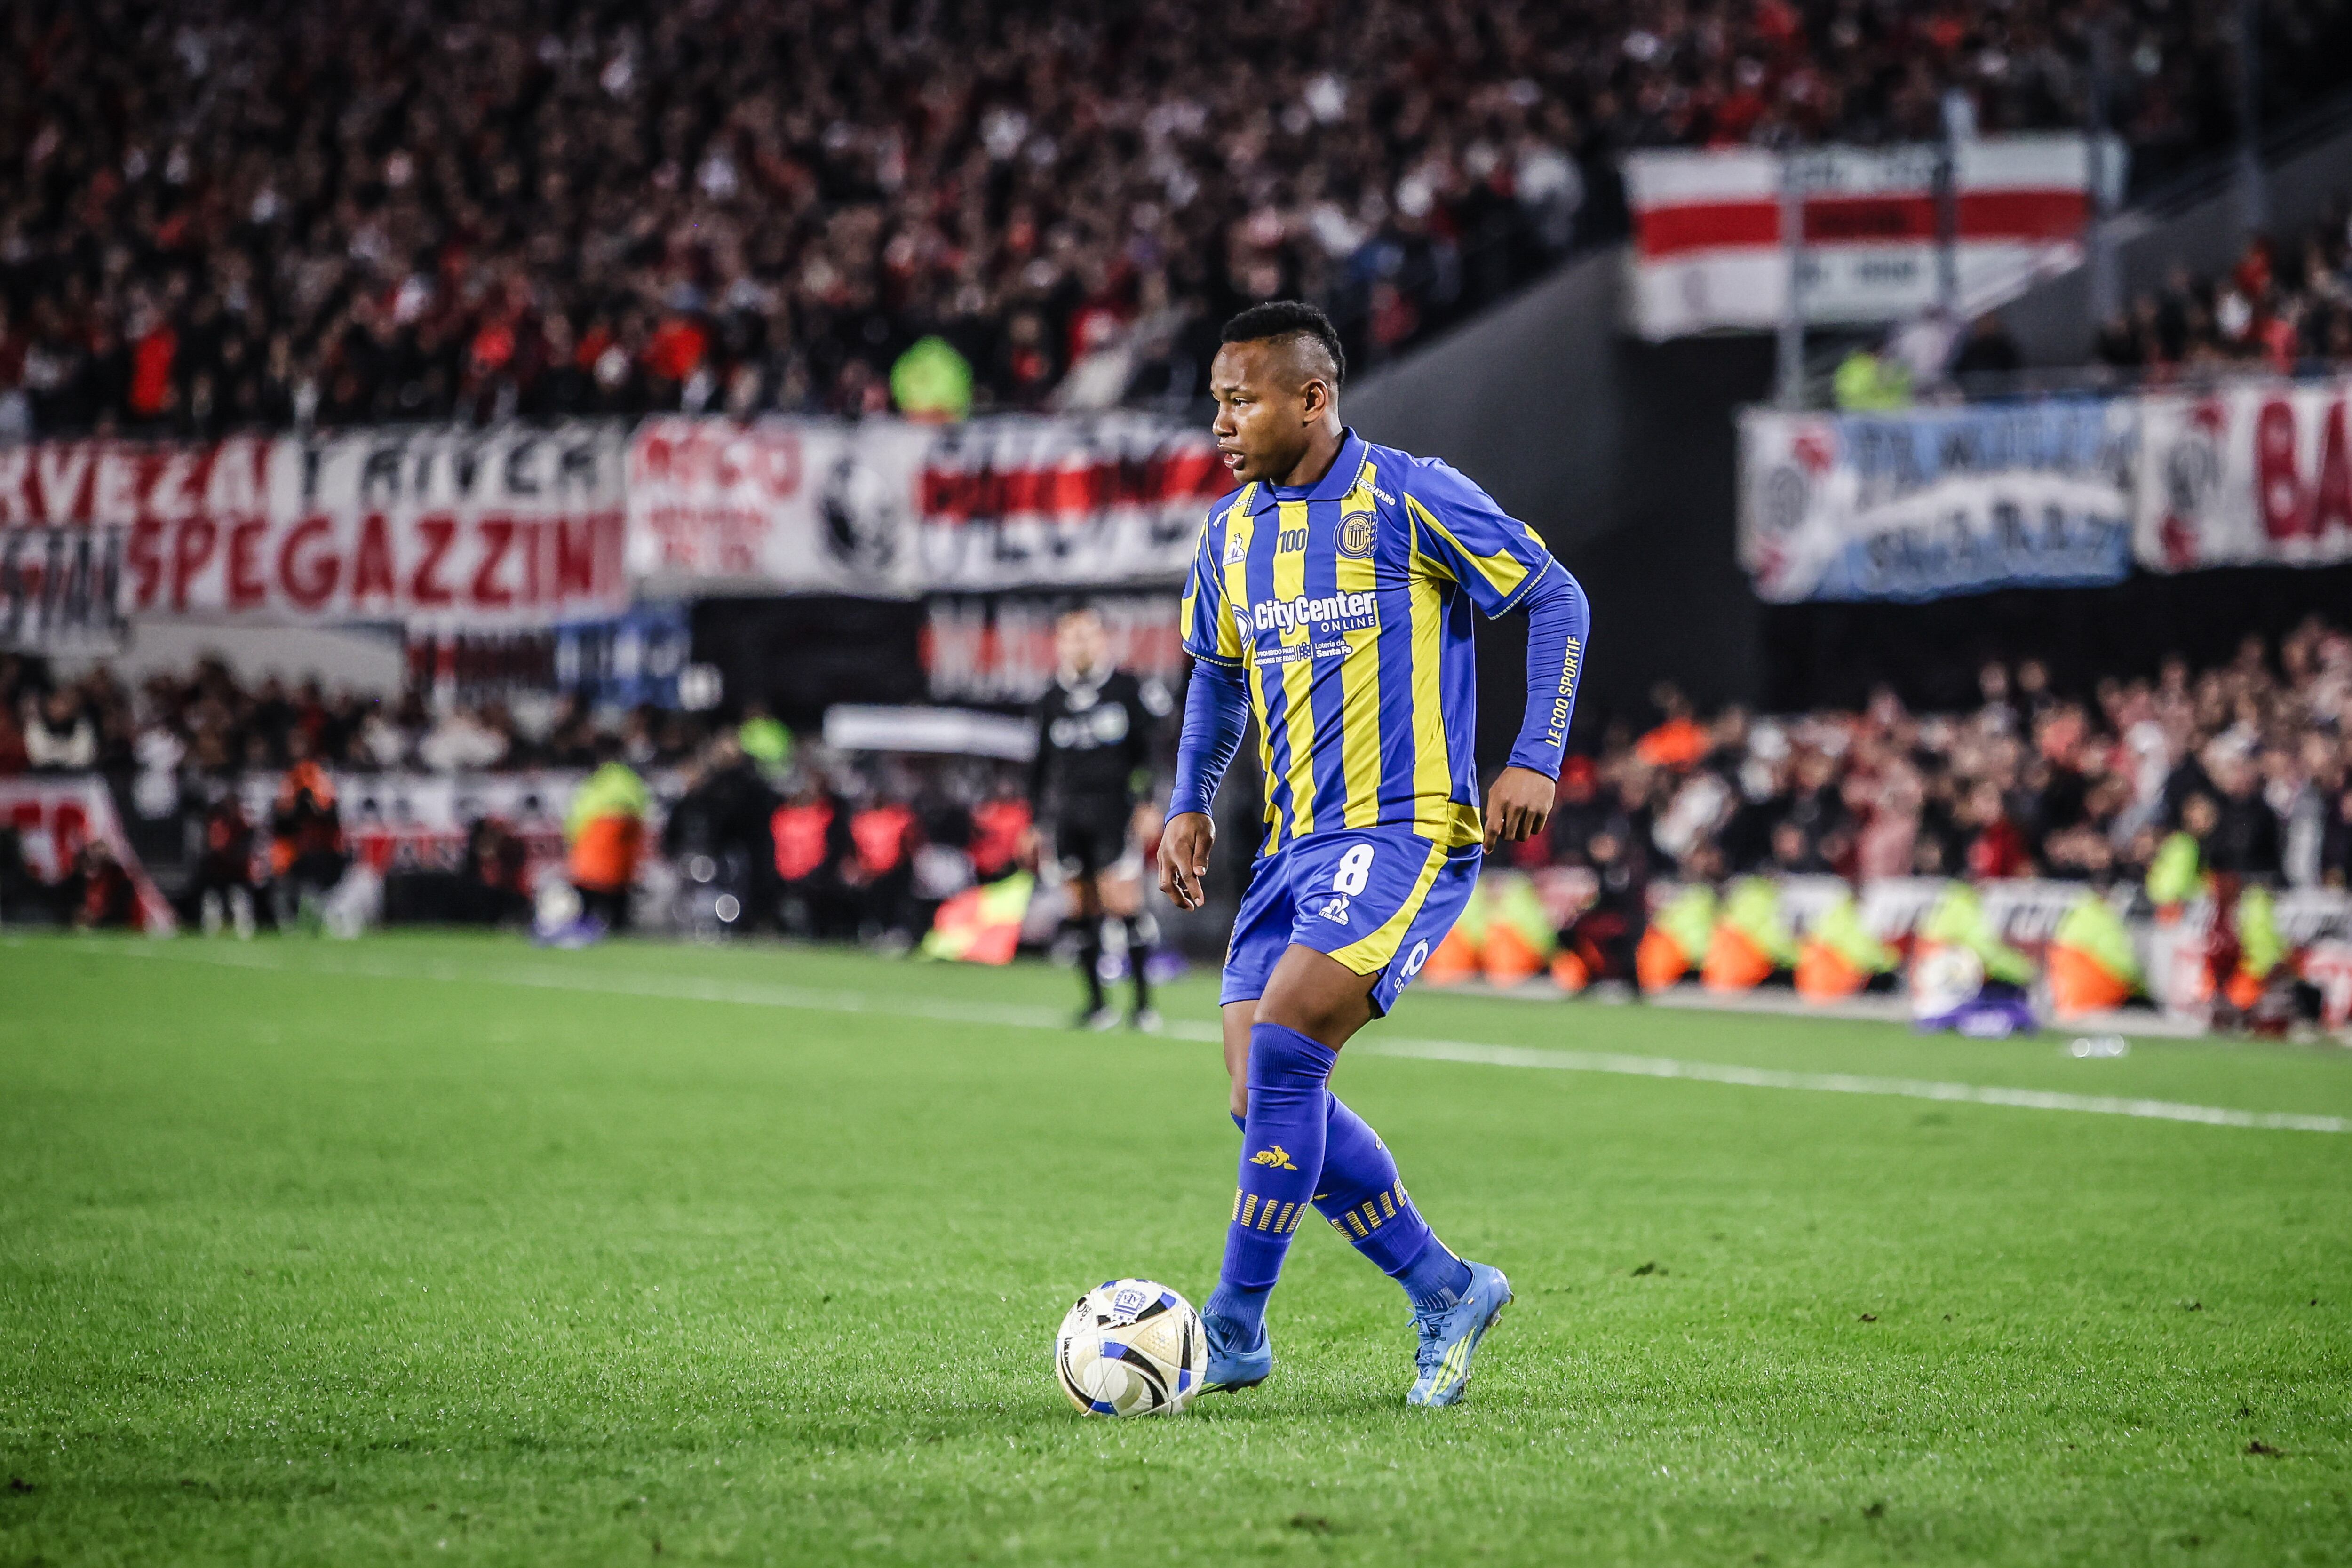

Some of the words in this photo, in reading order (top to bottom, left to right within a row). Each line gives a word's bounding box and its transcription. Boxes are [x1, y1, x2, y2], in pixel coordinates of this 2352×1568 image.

[1279, 528, 1307, 554] 100
[1255, 591, 1376, 634] CityCenter
[1321, 616, 1375, 632] ONLINE
[1315, 641, 1336, 649] Lotería
[1316, 647, 1341, 658] Santa
[1341, 646, 1351, 654] Fe
[1558, 636, 1581, 697] SPORTIF
[1550, 698, 1570, 729] COQ
[1545, 728, 1562, 748] LE
[1333, 844, 1375, 897] 8
